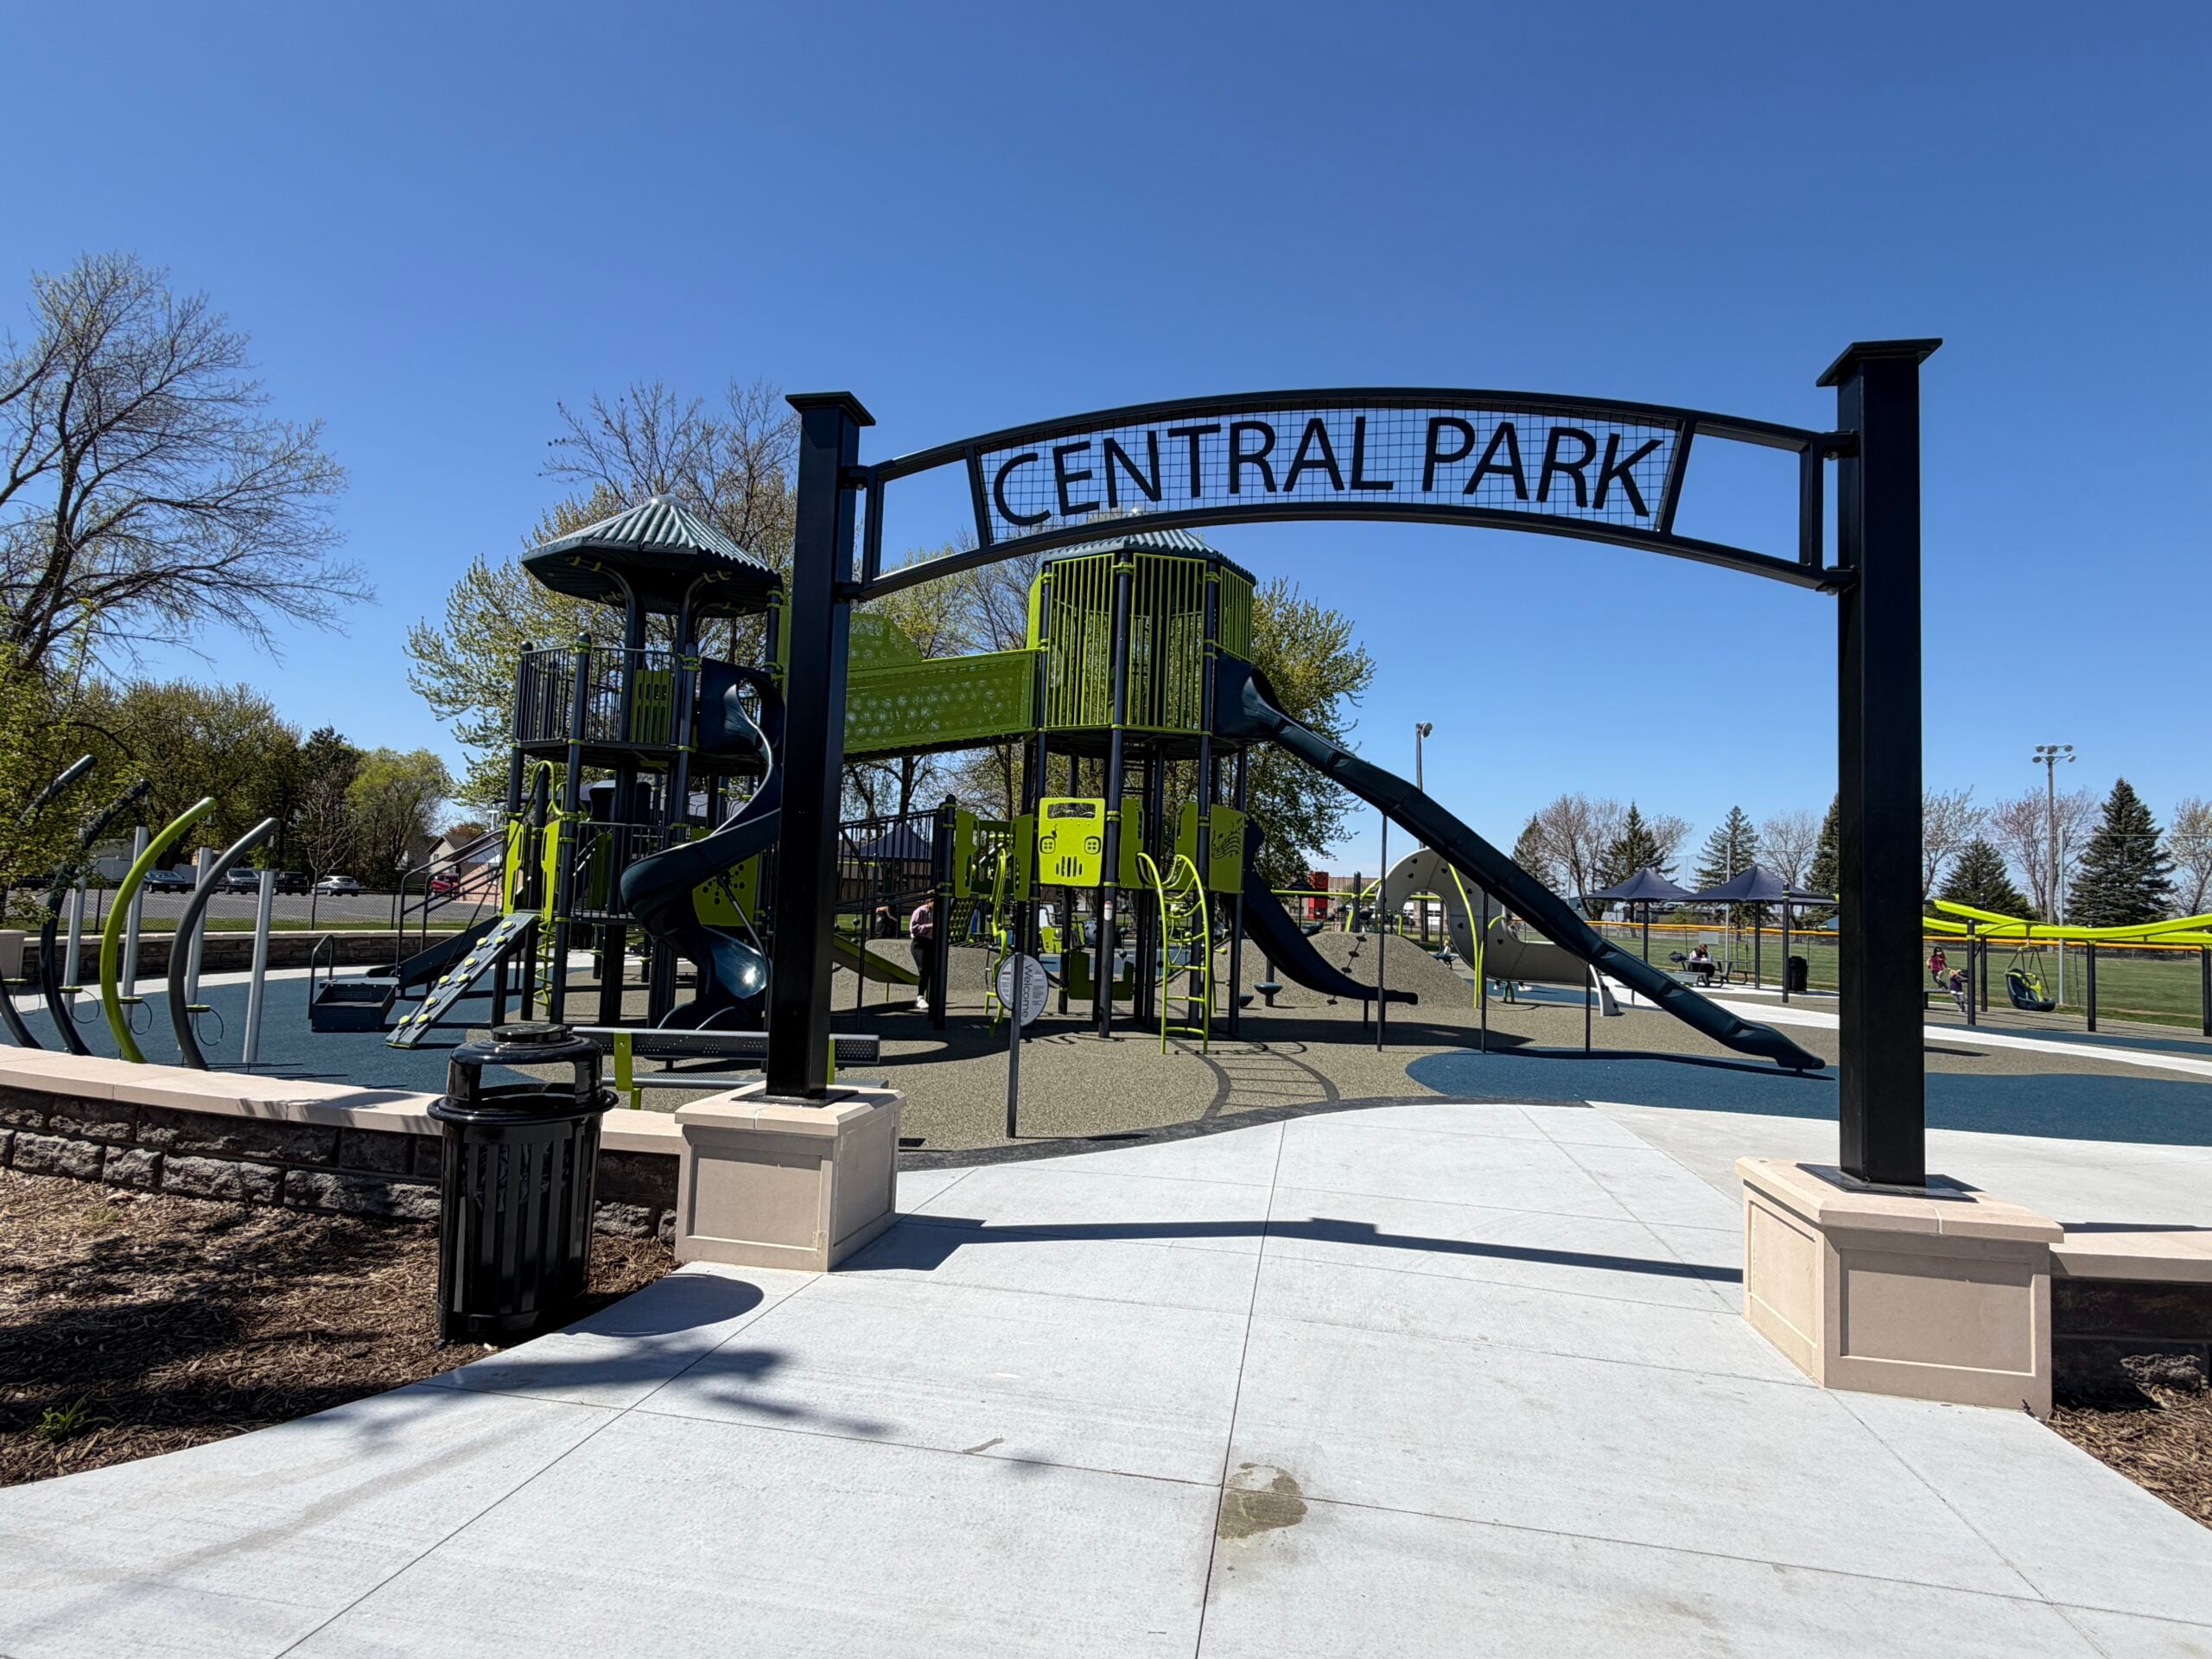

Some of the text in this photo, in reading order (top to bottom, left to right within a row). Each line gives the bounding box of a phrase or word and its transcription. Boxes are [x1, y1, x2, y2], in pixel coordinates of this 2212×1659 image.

[993, 416, 1664, 525] CENTRAL PARK
[1022, 964, 1033, 1018] Welcome
